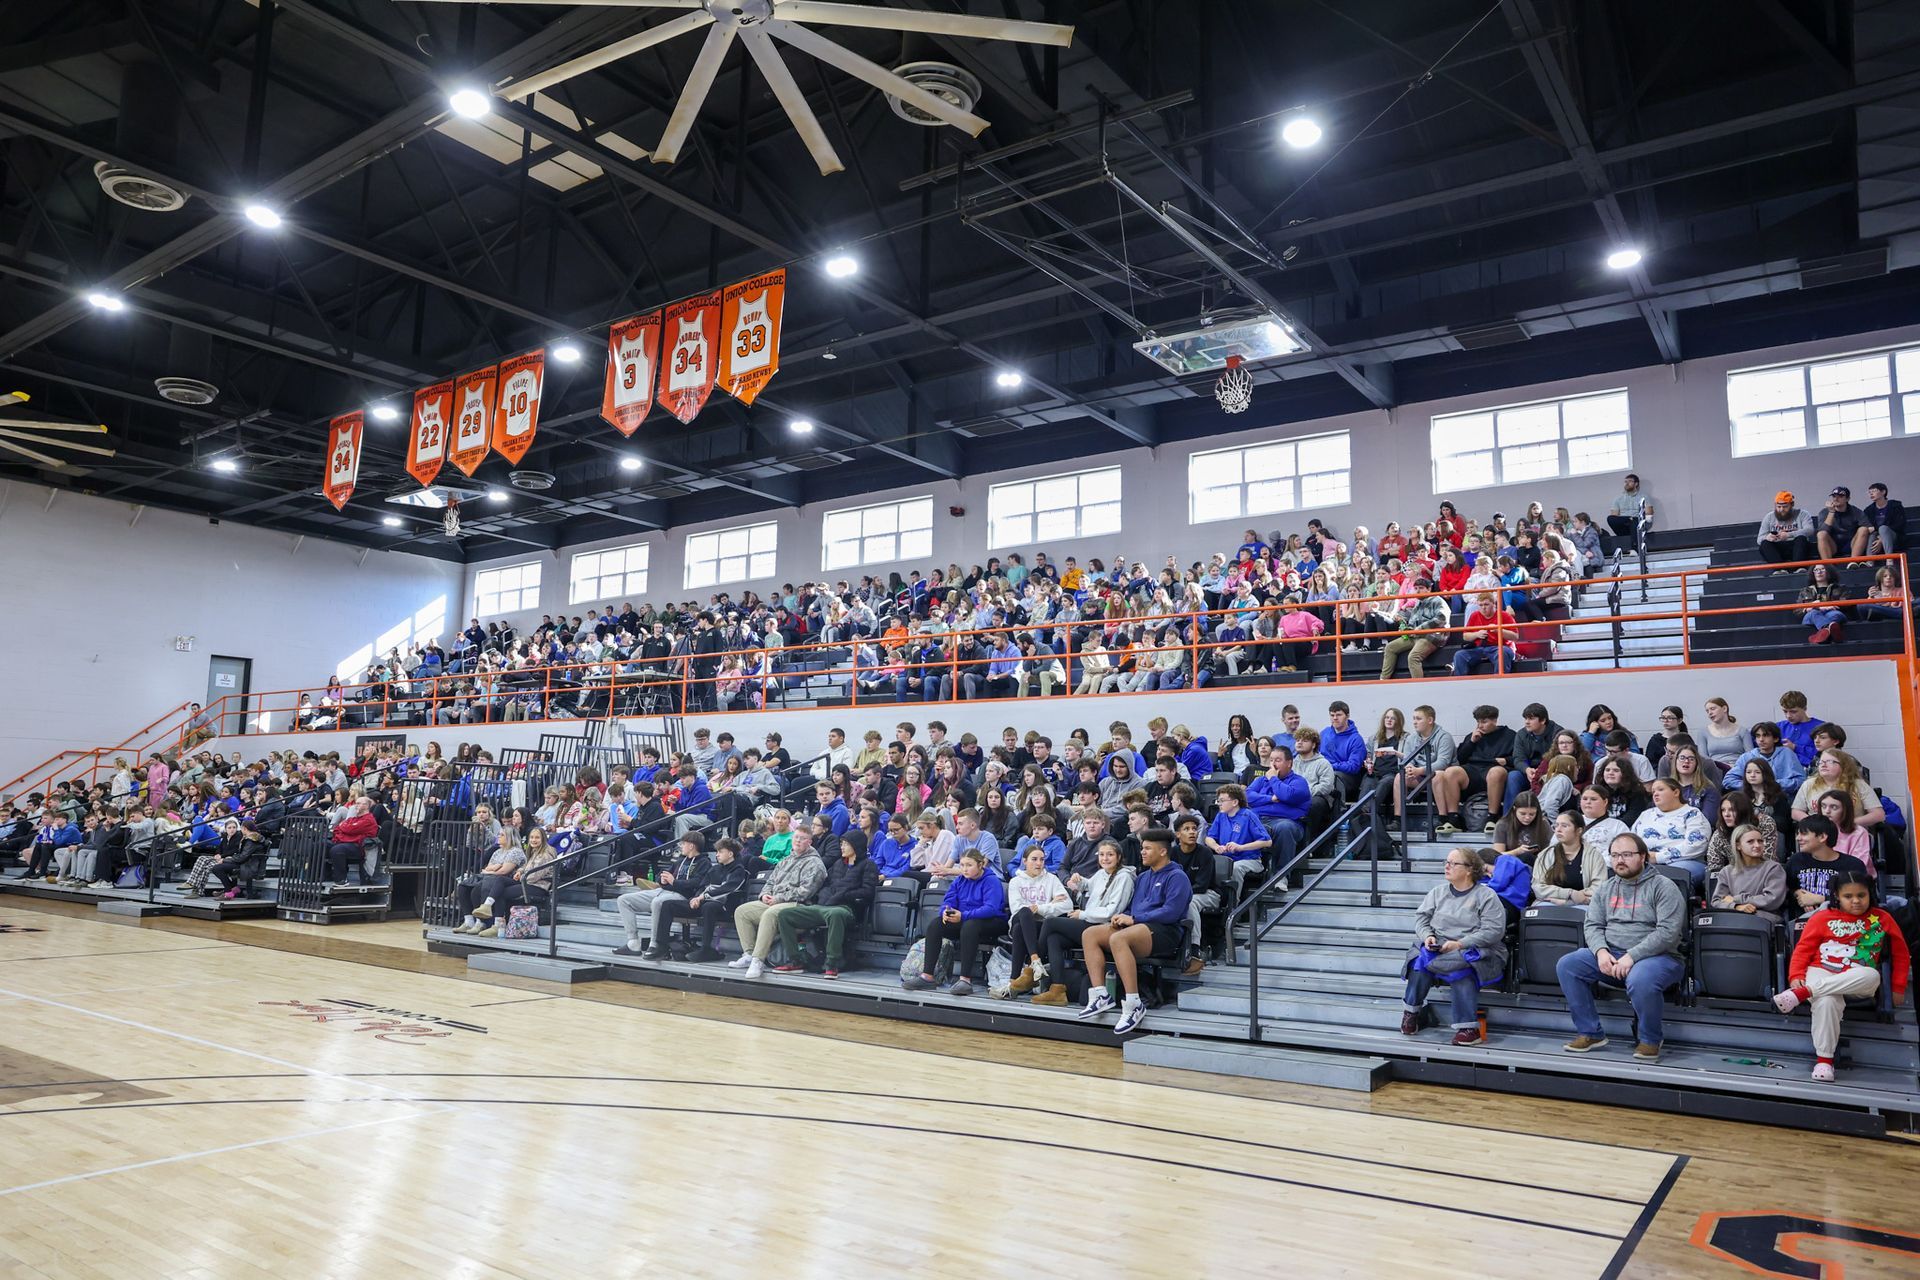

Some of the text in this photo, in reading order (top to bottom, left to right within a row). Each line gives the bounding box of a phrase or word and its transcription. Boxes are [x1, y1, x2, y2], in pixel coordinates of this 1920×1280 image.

[725, 275, 784, 302] UNION COLLEGE
[666, 297, 720, 322] UNION COLLEGE
[737, 324, 766, 358] 33
[675, 344, 702, 375] 34
[624, 363, 636, 389] 3
[509, 391, 528, 417] 10
[420, 424, 440, 449] 22
[461, 411, 481, 437] 29
[334, 450, 350, 473] 34
[1800, 867, 1840, 876] KENTUCK
